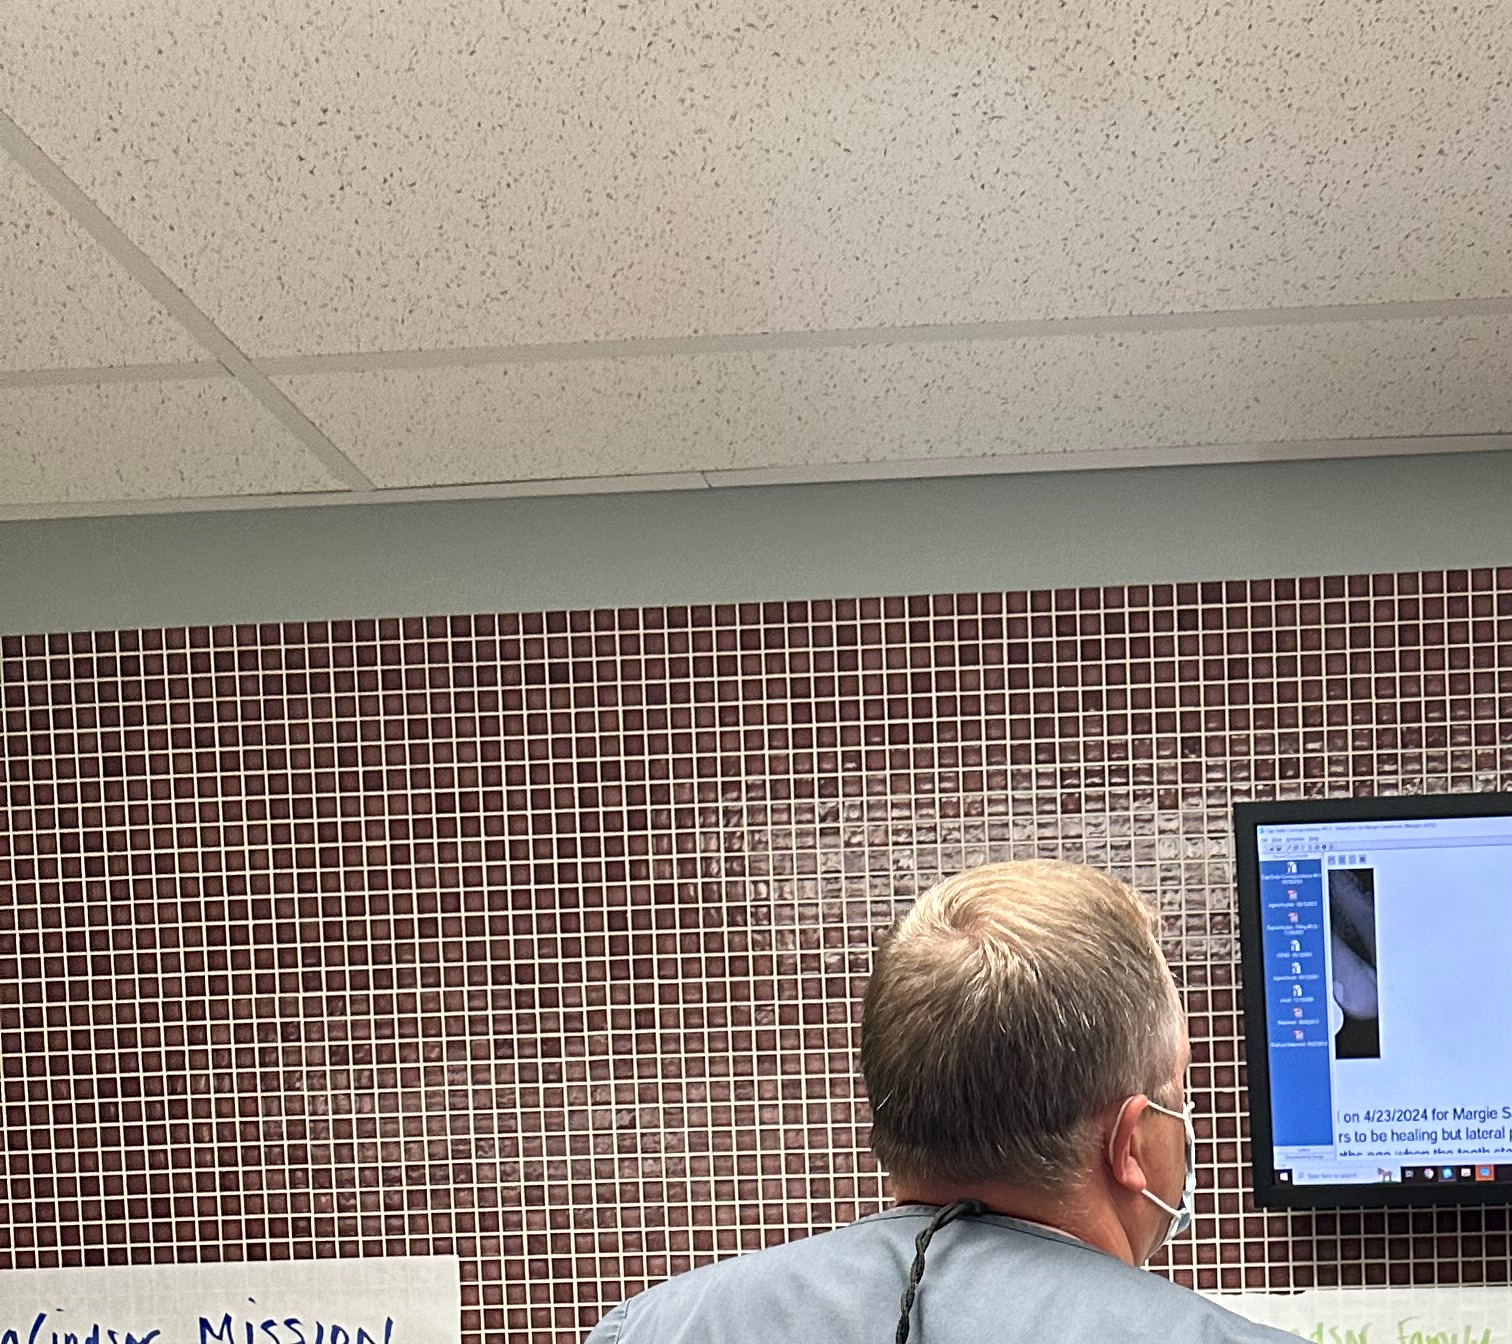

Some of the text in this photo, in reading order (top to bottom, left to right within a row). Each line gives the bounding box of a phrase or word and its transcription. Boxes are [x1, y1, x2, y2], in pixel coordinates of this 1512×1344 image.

[1344, 1112, 1359, 1124] on
[1364, 1107, 1428, 1123] 4/23/2024
[1432, 1107, 1449, 1121] for
[1453, 1106, 1497, 1123] Margie
[1355, 1131, 1366, 1143] to
[1371, 1129, 1387, 1143] be
[1391, 1128, 1437, 1145] healing
[1442, 1127, 1462, 1141] but
[1466, 1126, 1505, 1141] lateral
